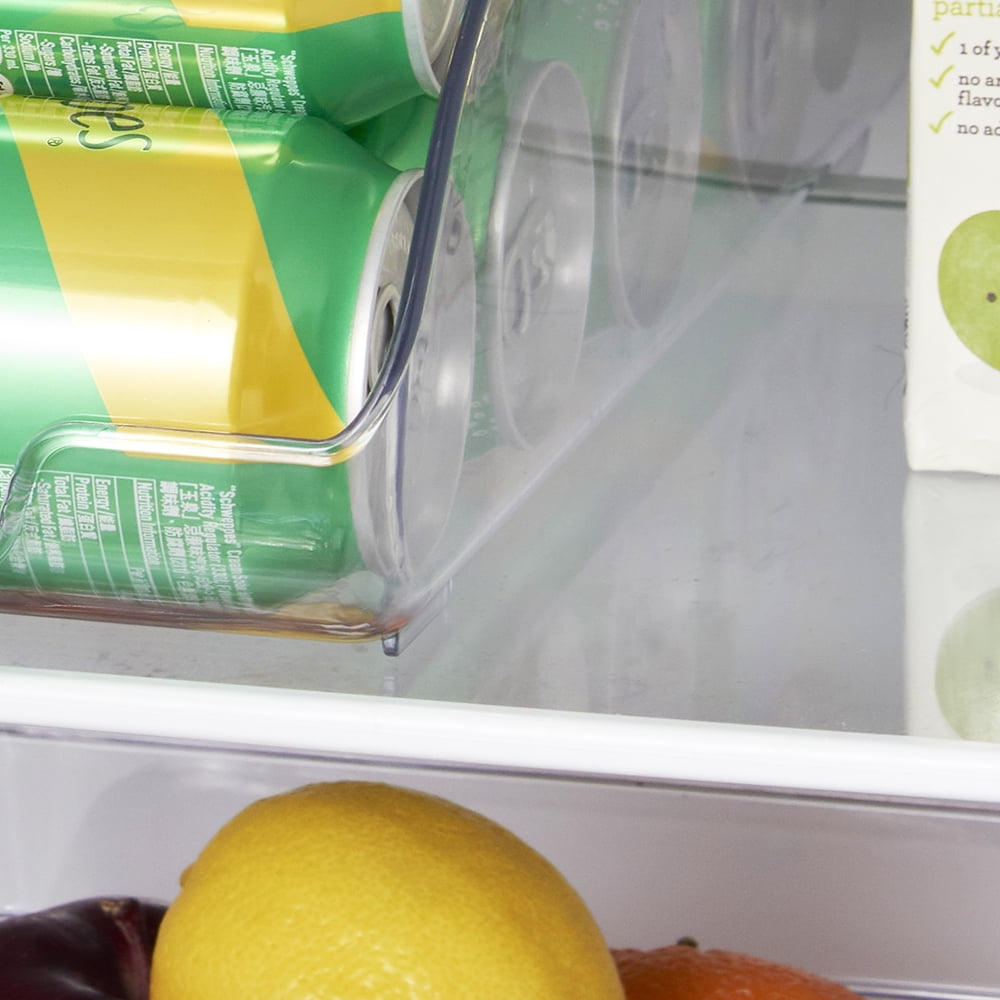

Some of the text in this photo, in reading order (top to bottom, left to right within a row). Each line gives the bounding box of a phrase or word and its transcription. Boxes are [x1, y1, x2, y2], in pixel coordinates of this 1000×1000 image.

[0, 29, 17, 60] Per 330
[19, 33, 35, 60] Sodium
[117, 41, 134, 73] Total Fat
[137, 42, 155, 69] Protein
[157, 43, 176, 69] Energy
[972, 40, 991, 56] of
[59, 36, 82, 86] Carbohydrates
[199, 46, 217, 78] Nutrition
[260, 48, 277, 77] Acidity
[958, 75, 980, 86] no
[957, 124, 979, 135] no
[54, 475, 72, 516] Total Fat
[74, 476, 92, 511] Protein
[95, 478, 112, 512] Energy
[136, 482, 153, 526] Nutrition
[199, 483, 222, 565] Acidity Regulator
[140, 524, 161, 566] Information
